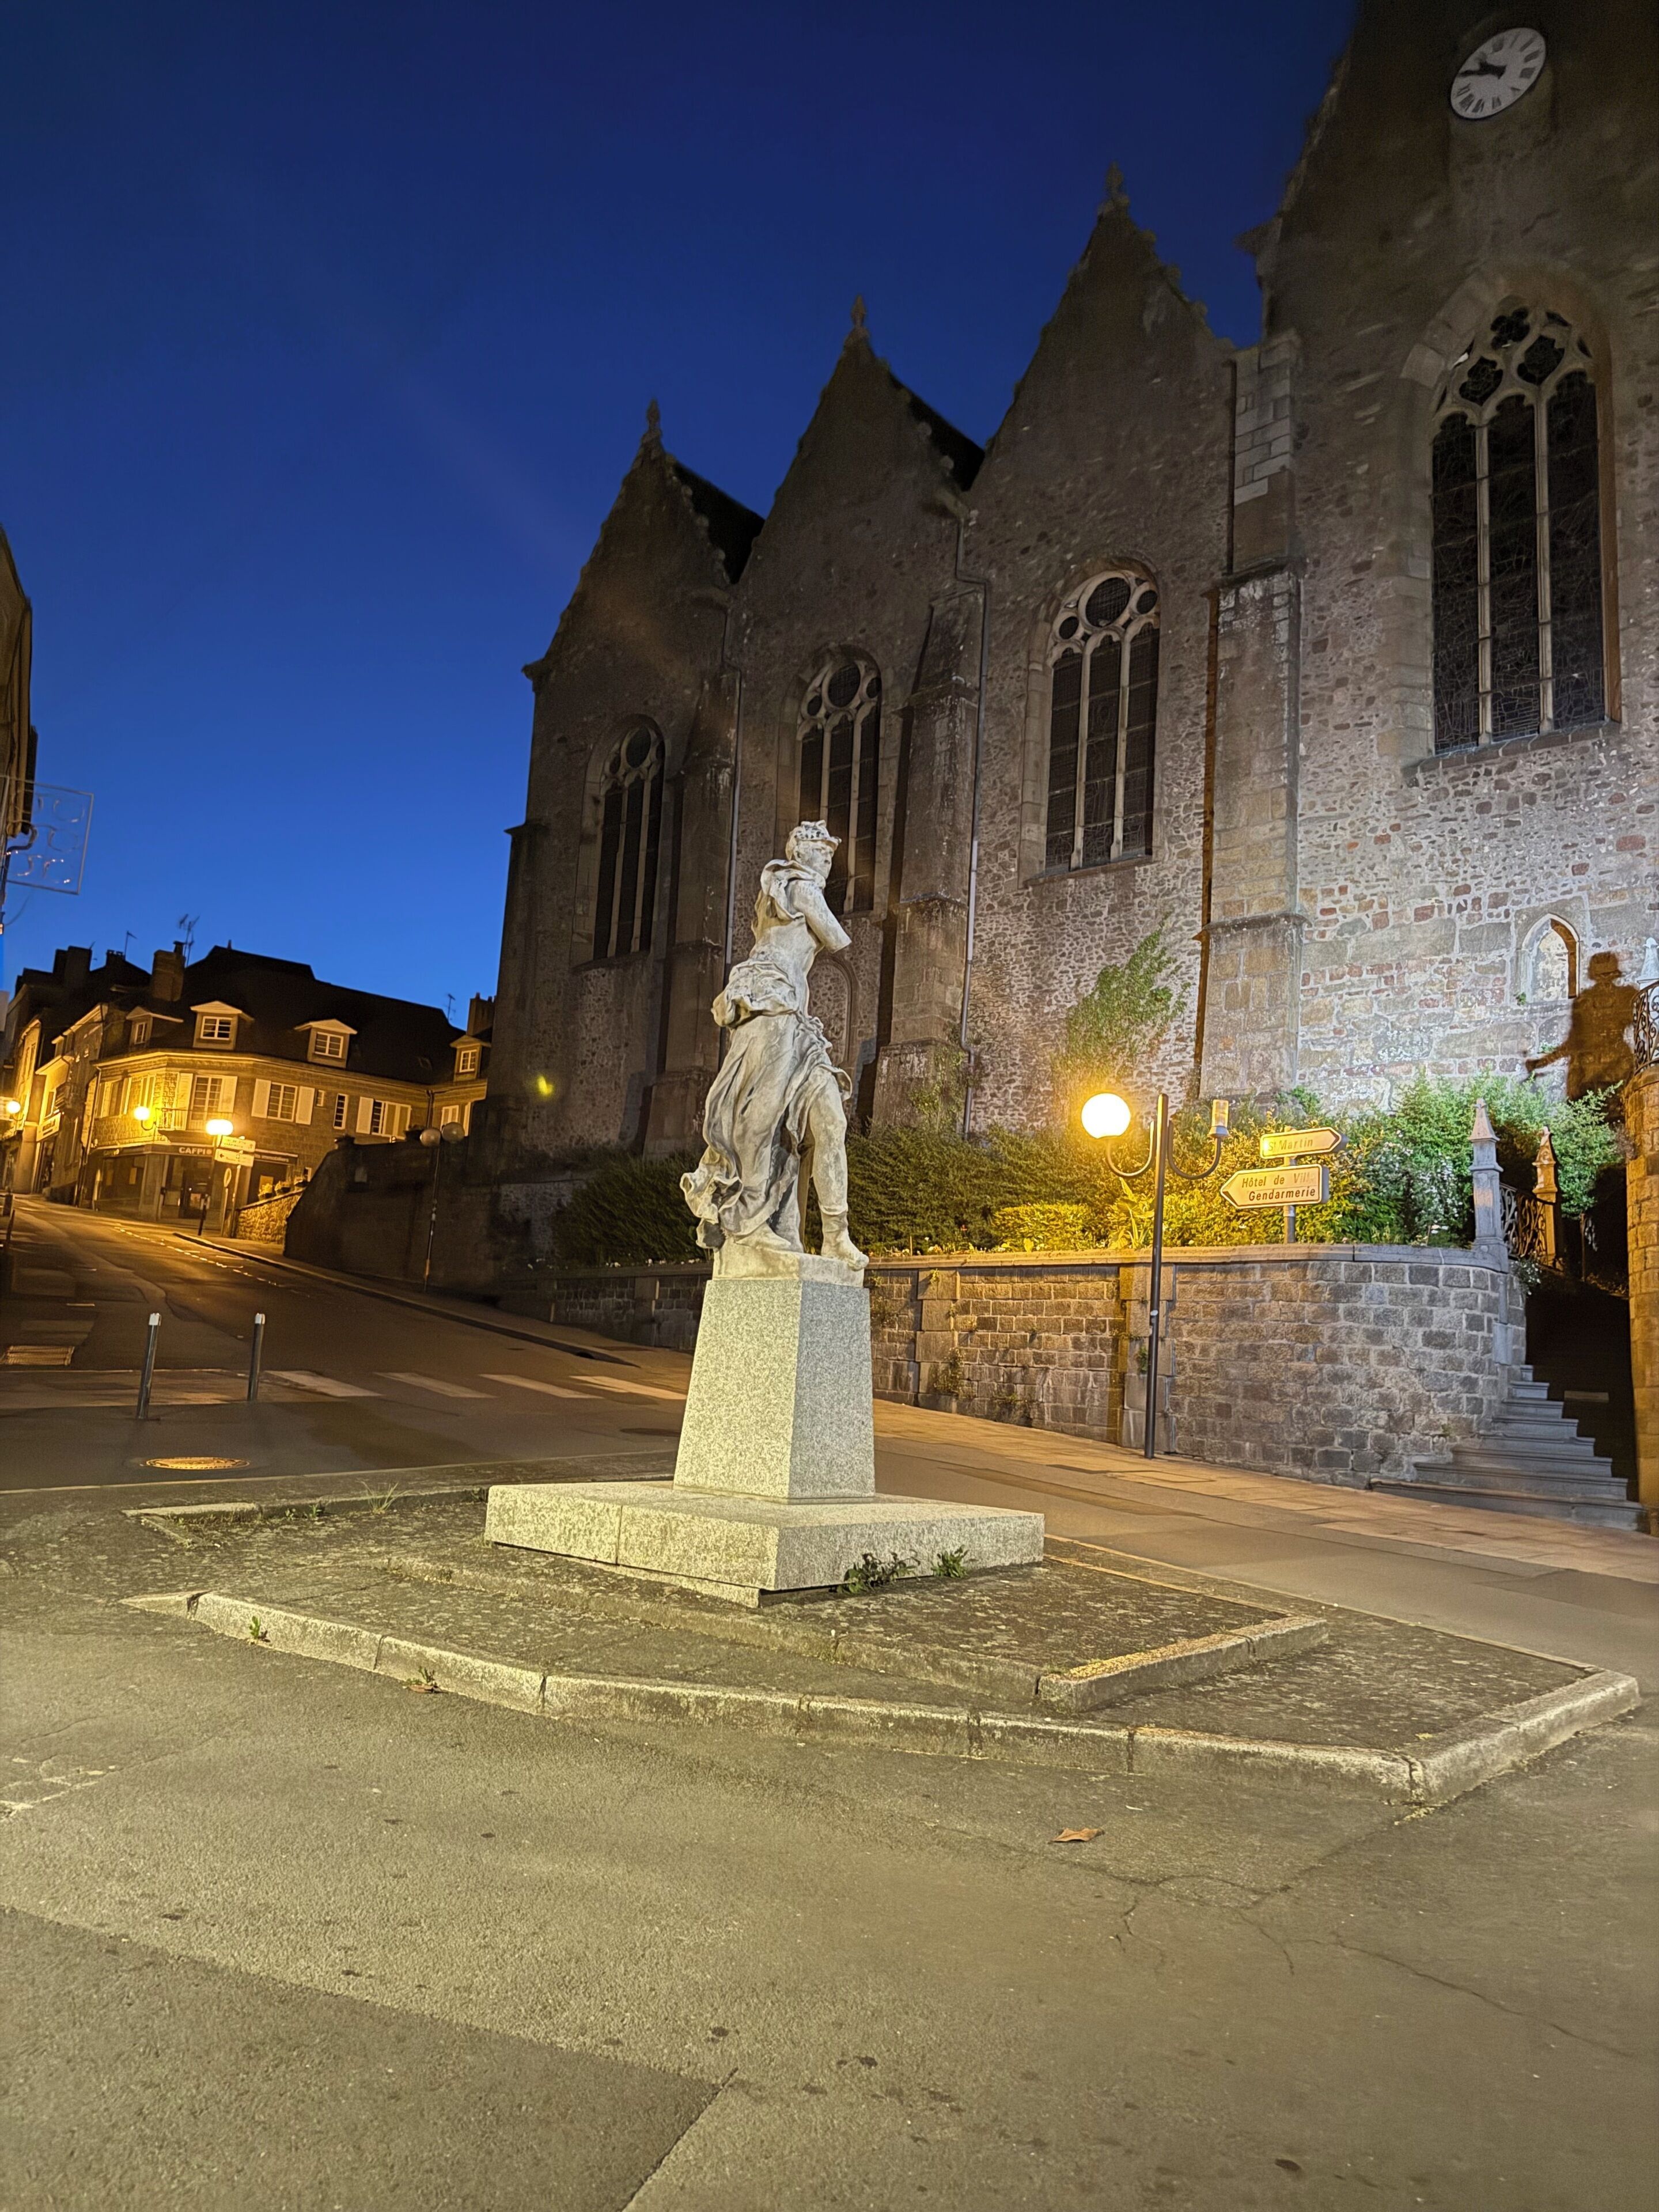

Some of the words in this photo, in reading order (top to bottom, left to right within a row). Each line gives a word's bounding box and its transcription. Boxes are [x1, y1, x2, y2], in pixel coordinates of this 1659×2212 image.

[1279, 1137, 1313, 1150] Martin
[179, 1147, 206, 1155] CAFPI
[1242, 1176, 1267, 1188] Hôtel
[1274, 1175, 1285, 1185] de
[1249, 1186, 1316, 1201] Gendarmerie
